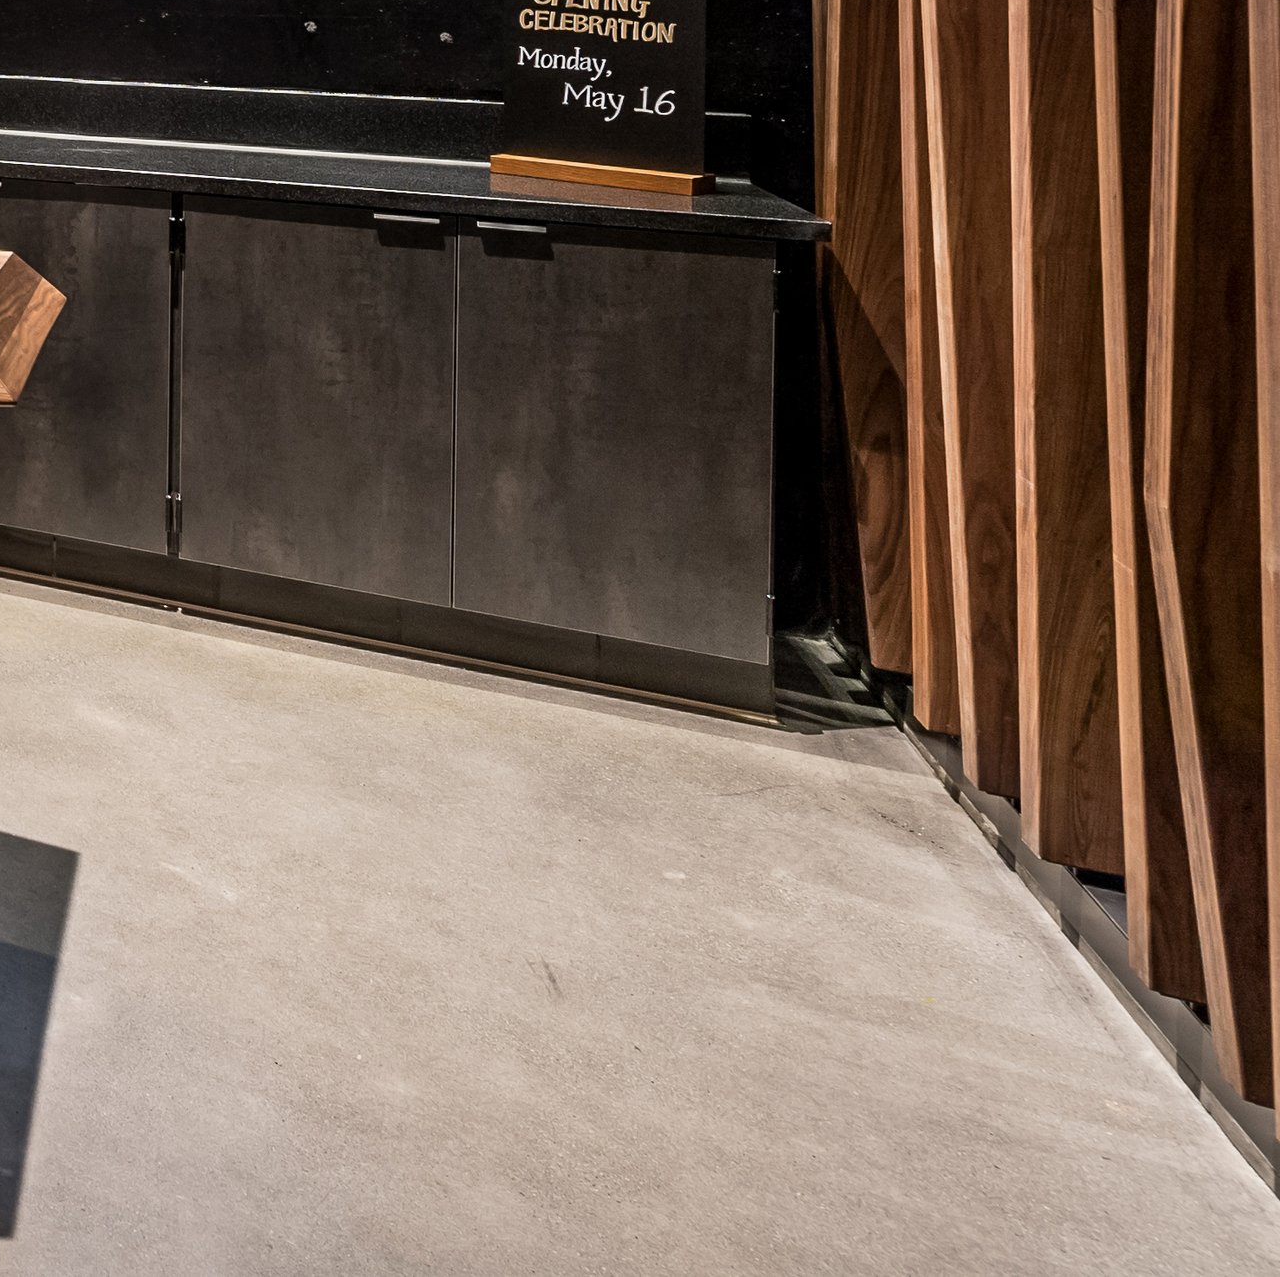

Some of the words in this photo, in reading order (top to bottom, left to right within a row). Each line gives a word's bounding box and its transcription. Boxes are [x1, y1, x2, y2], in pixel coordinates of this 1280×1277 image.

[519, 8, 677, 44] CELEBRATION
[517, 46, 613, 81] Monday,
[561, 82, 625, 122] May
[633, 85, 676, 115] 16
